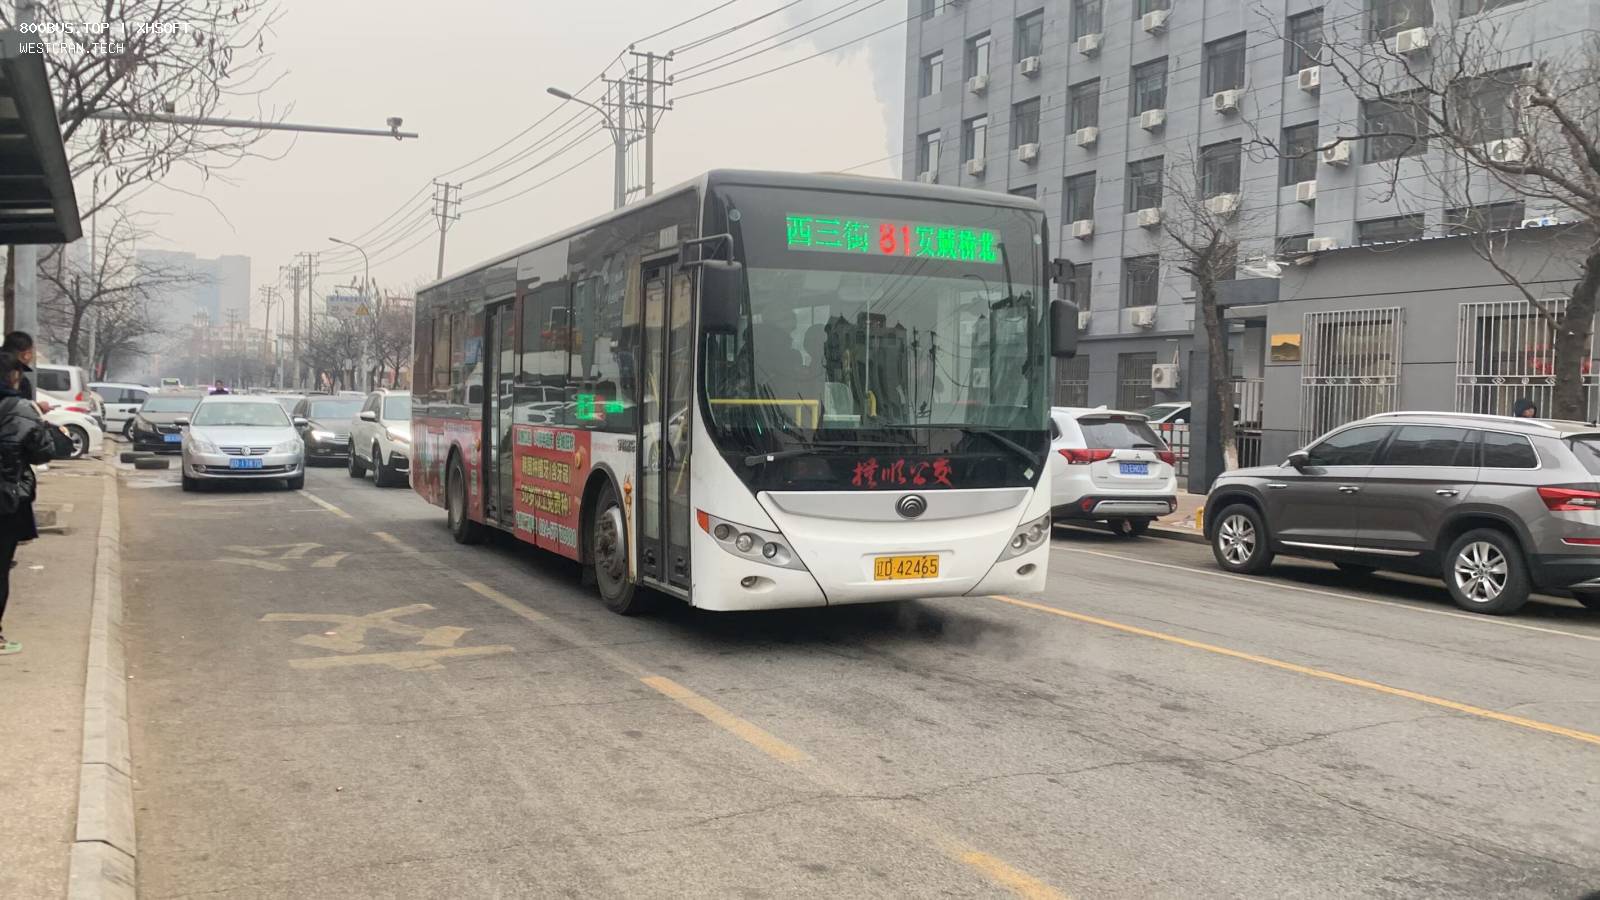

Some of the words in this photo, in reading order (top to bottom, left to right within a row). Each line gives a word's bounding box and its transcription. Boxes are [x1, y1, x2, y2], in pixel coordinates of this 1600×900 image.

[786, 215, 870, 253] 西三街
[879, 223, 911, 256] 81
